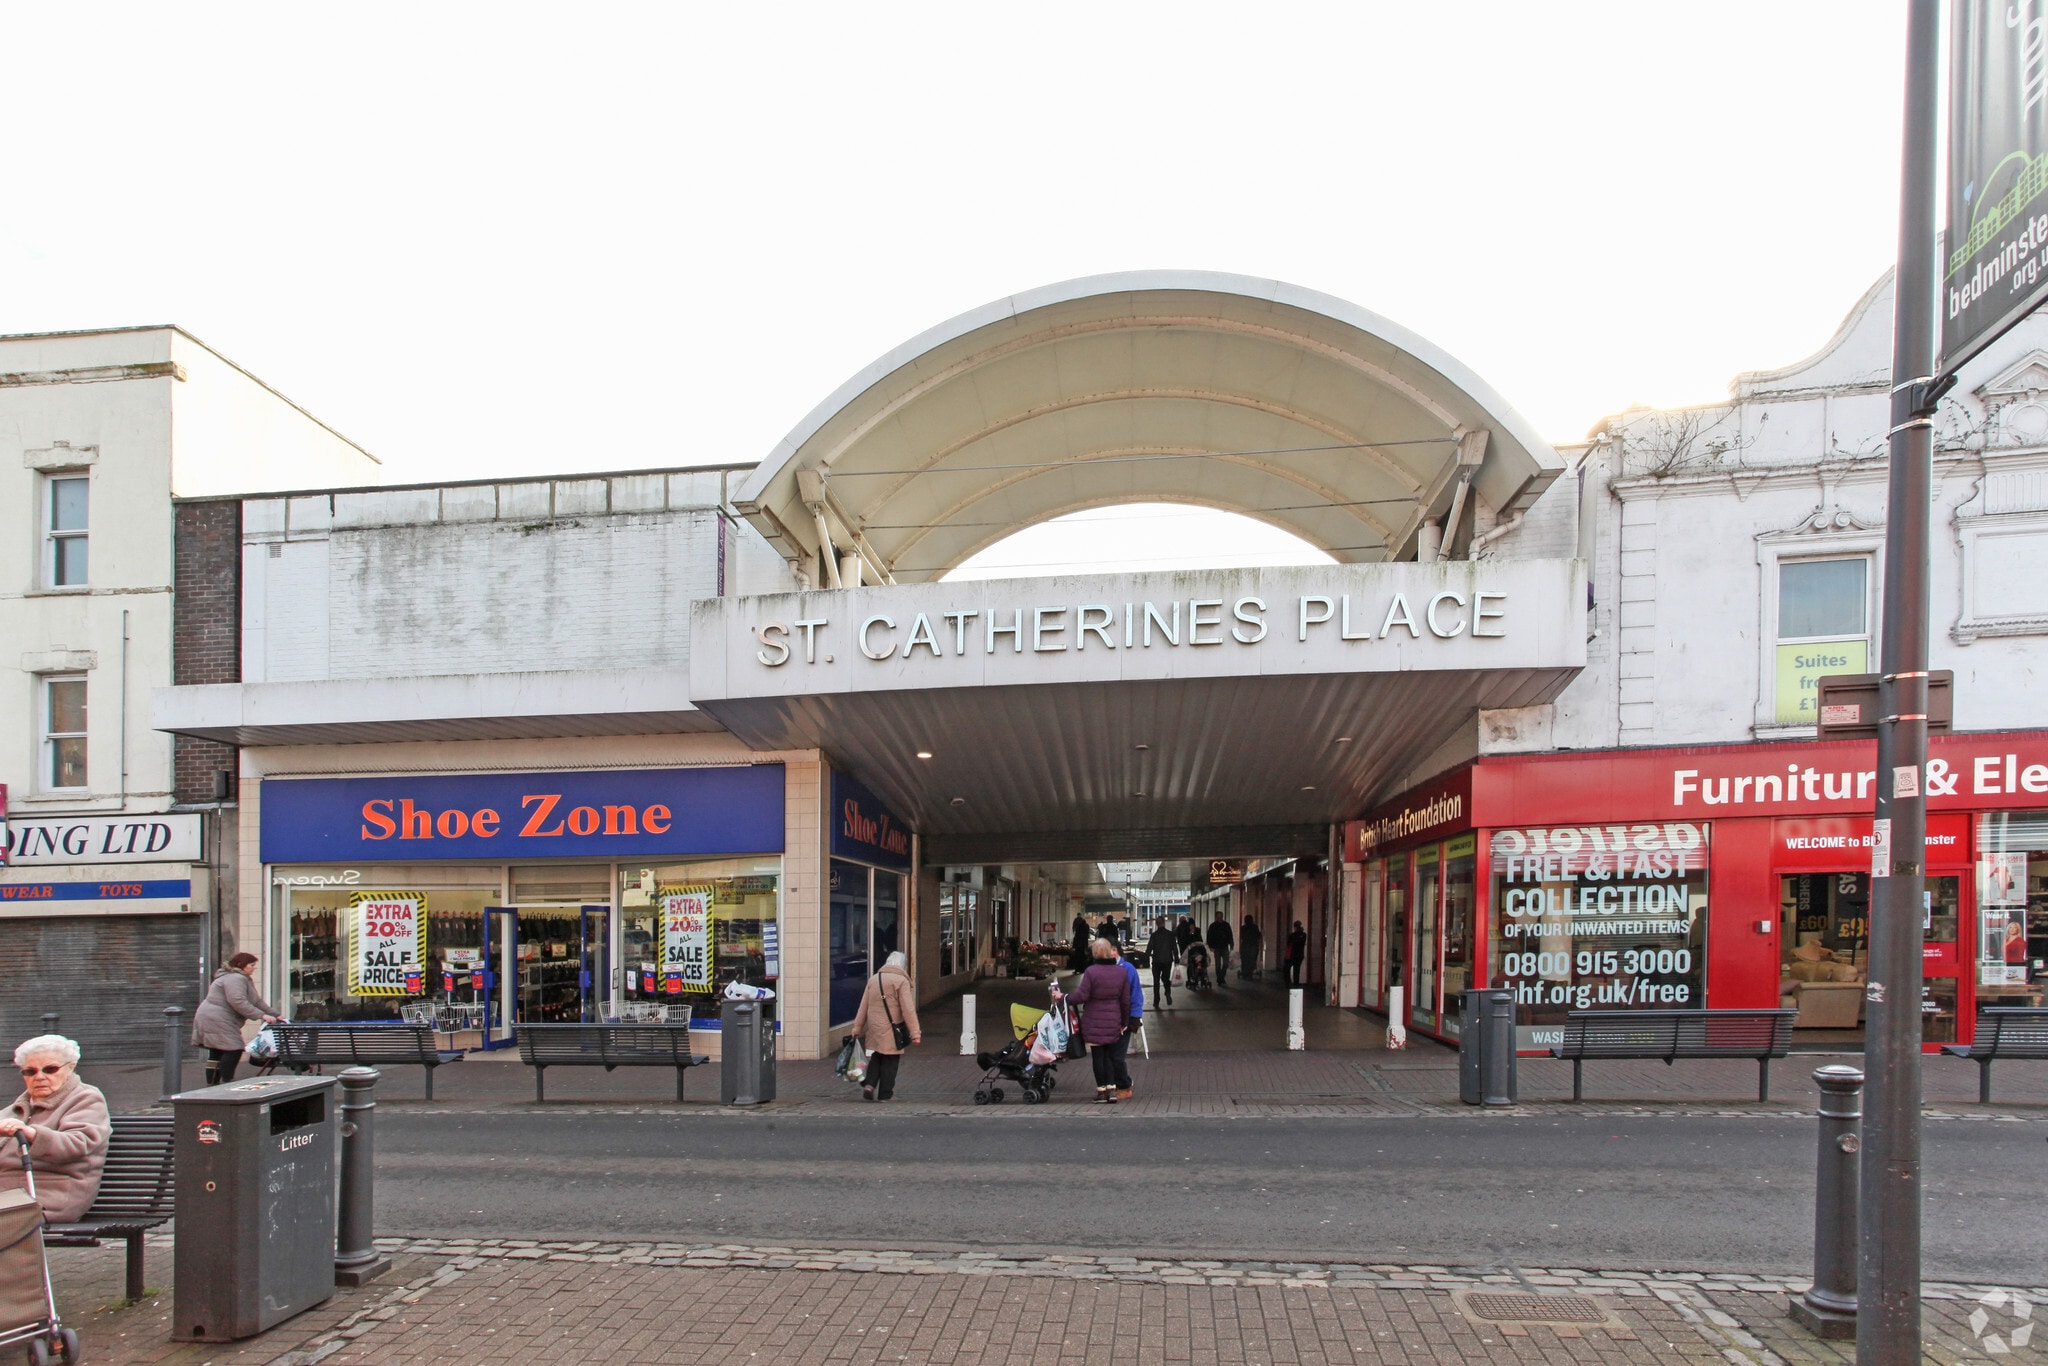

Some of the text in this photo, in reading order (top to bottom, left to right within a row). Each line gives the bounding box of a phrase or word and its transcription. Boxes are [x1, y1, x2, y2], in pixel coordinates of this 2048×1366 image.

[757, 591, 1508, 667] ST. CATHERINES PLACE
[1794, 654, 1847, 668] Suites
[1673, 763, 1876, 806] Furnitur
[1926, 758, 1958, 796] &
[361, 794, 672, 840] Shoe Zone
[1360, 792, 1461, 851] British Heart Foundation
[844, 798, 908, 855] Shoe Zone
[99, 823, 172, 854] LTD
[1786, 836, 1846, 849] WELCOME
[1848, 837, 1859, 848] to
[1506, 849, 1687, 883] FREE & FAST
[0, 883, 143, 899] WEAR TOYS
[669, 898, 703, 915] EXTRA
[1505, 884, 1688, 917] COLLECTION
[366, 904, 412, 920] EXTRA
[366, 921, 412, 938] 20% OFF
[669, 916, 698, 932] 20%
[1504, 919, 1690, 938] OF YOUR UNWANTED ITEMS
[379, 939, 397, 950] ALL
[679, 934, 692, 944] ALL
[364, 951, 411, 967] SALE
[668, 946, 703, 962] SALE
[1504, 949, 1691, 977] 0800 915 3000
[281, 1133, 314, 1152] Litter
